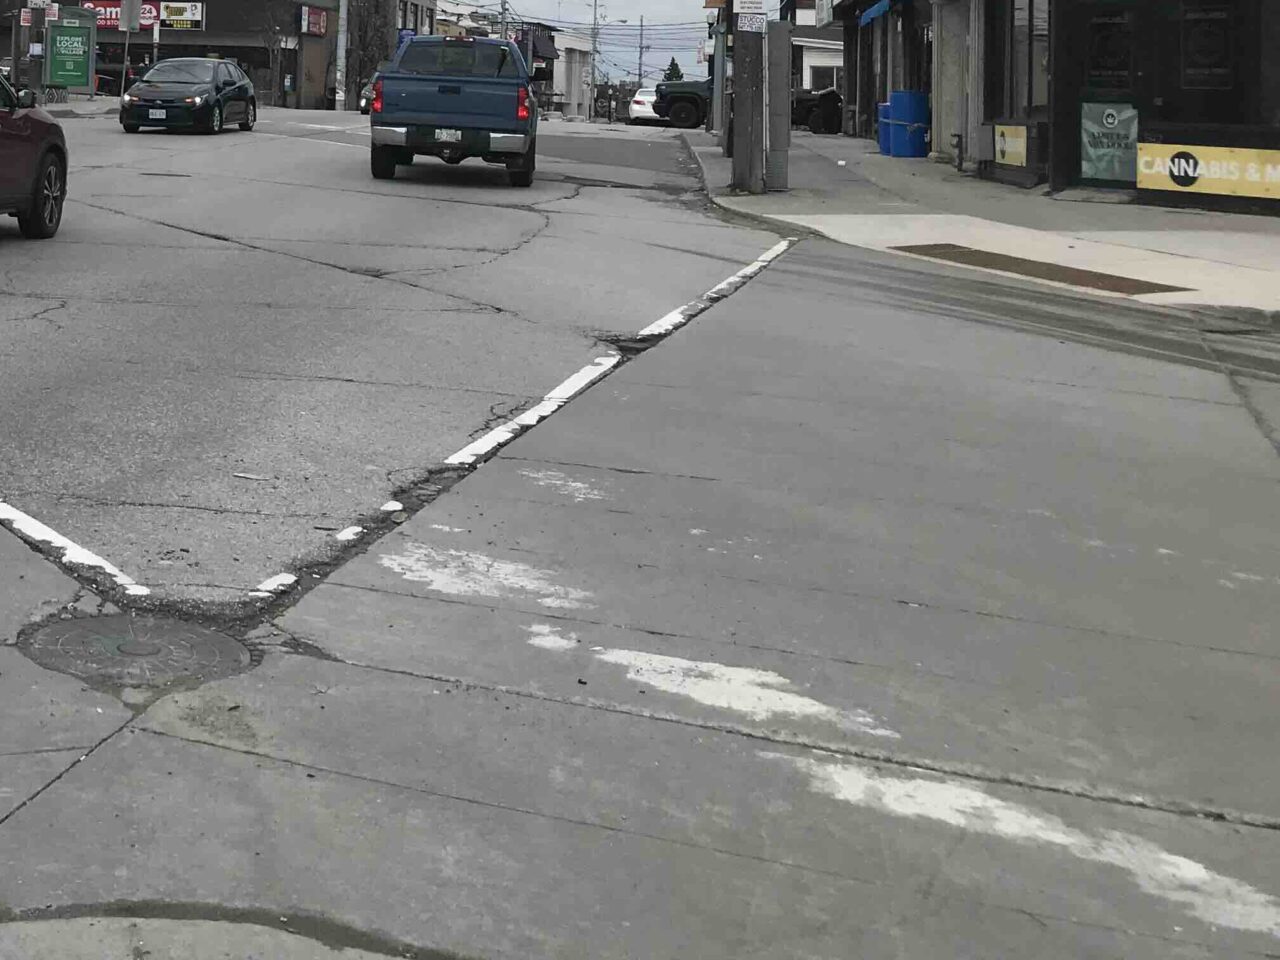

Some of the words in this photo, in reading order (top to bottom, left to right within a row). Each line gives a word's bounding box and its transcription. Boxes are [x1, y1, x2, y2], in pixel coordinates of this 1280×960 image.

[141, 7, 152, 15] 24
[1139, 157, 1240, 181] CANNABIS
[1246, 162, 1260, 179] &
